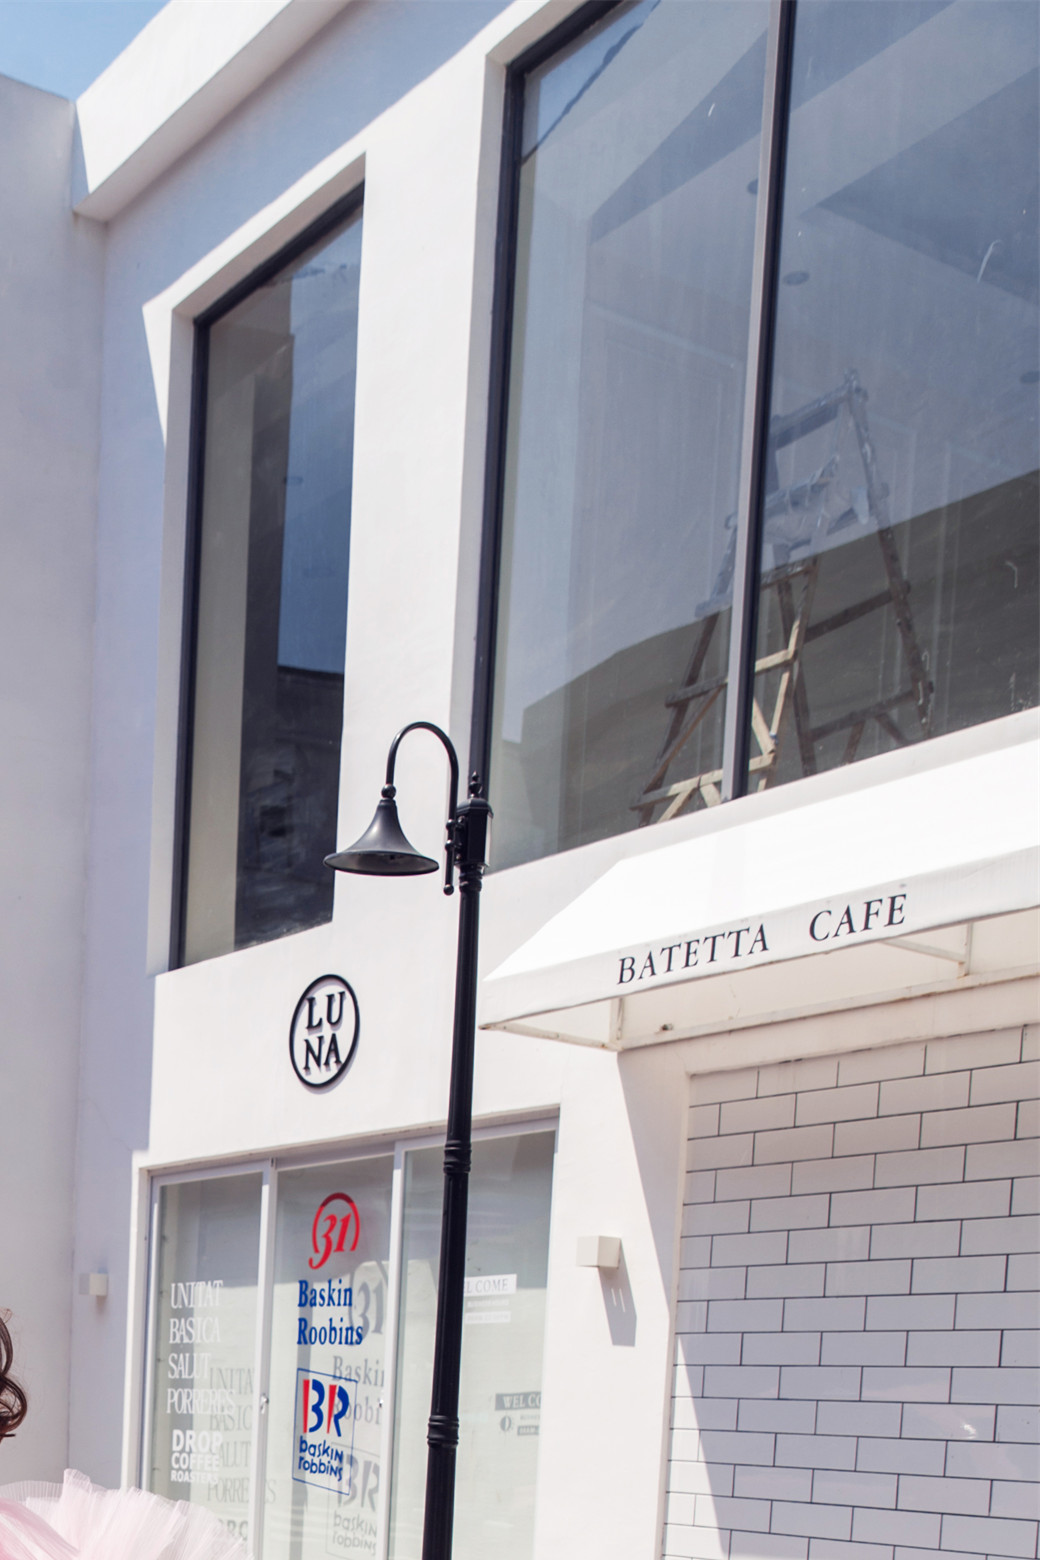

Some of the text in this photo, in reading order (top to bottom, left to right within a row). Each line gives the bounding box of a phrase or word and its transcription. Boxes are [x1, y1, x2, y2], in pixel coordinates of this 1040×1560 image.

[617, 893, 907, 985] BATETTA CAFE
[305, 990, 346, 1030] LU
[303, 1032, 343, 1073] NA
[309, 1212, 353, 1270] 31
[297, 1278, 353, 1308] Baskin
[296, 1317, 364, 1346] Roobins
[167, 1353, 211, 1379] SALUT
[303, 1378, 350, 1438] BR
[172, 1428, 223, 1453] DROP
[171, 1452, 220, 1472] COFFEE
